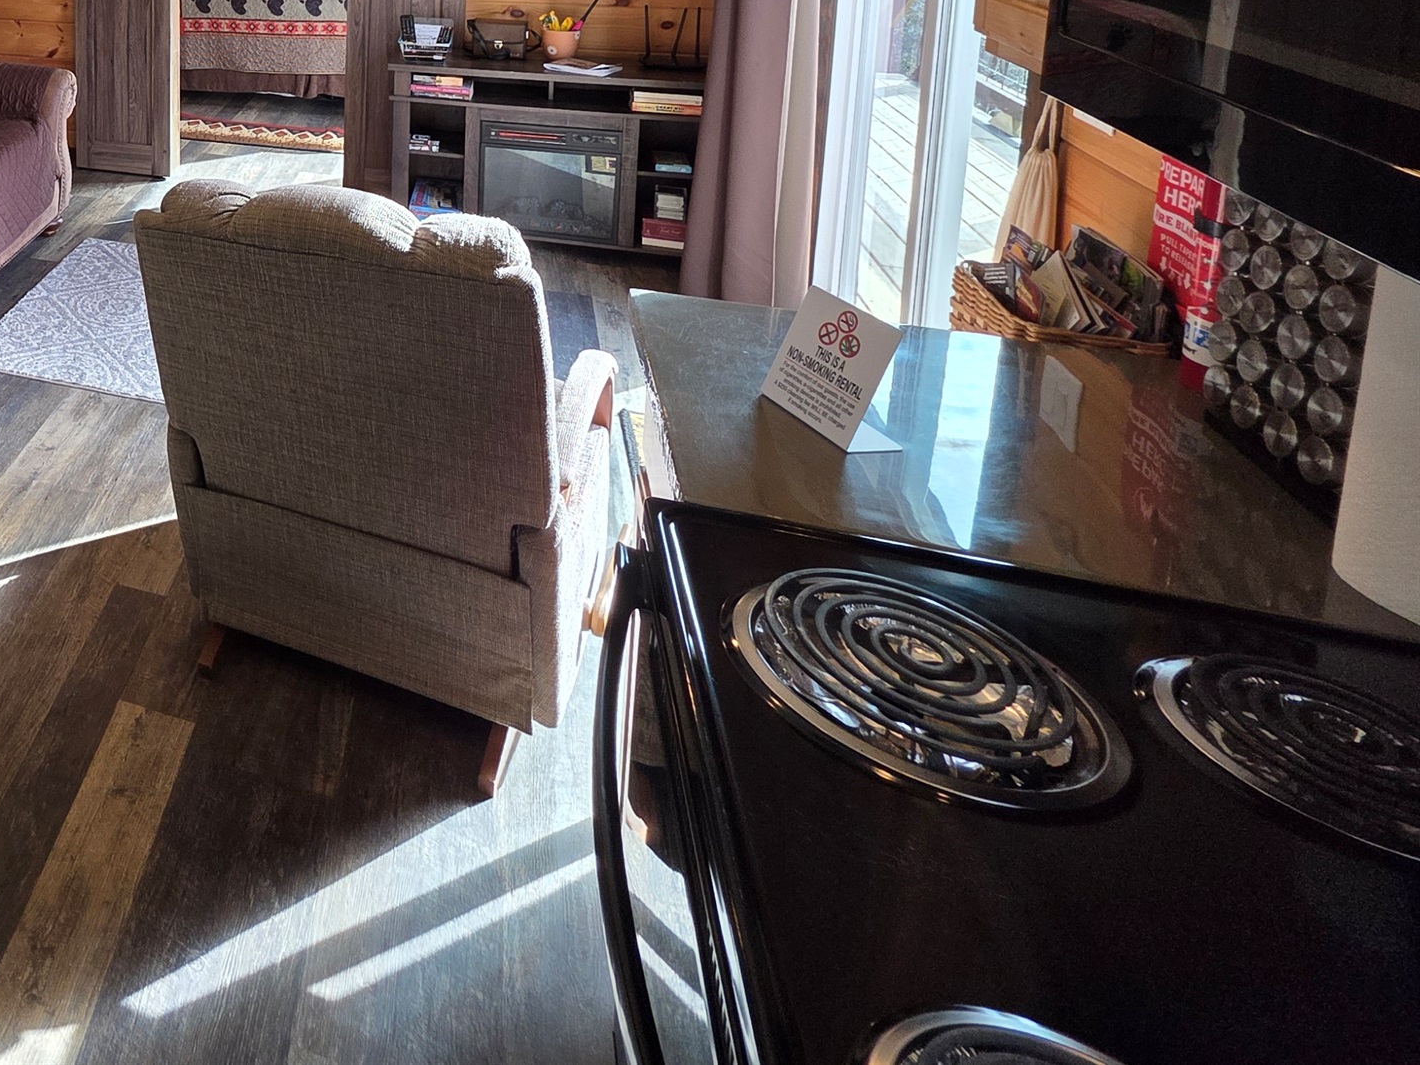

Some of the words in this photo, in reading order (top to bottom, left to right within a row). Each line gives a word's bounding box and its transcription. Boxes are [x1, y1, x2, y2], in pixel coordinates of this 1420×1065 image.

[1160, 232, 1178, 249] PULL
[1160, 243, 1171, 255] TO
[783, 360, 791, 368] For
[814, 345, 834, 364] THIS
[831, 354, 841, 368] IS
[838, 360, 846, 373] A
[786, 345, 837, 383] NON-SMOKING
[834, 374, 864, 401] RENTAL
